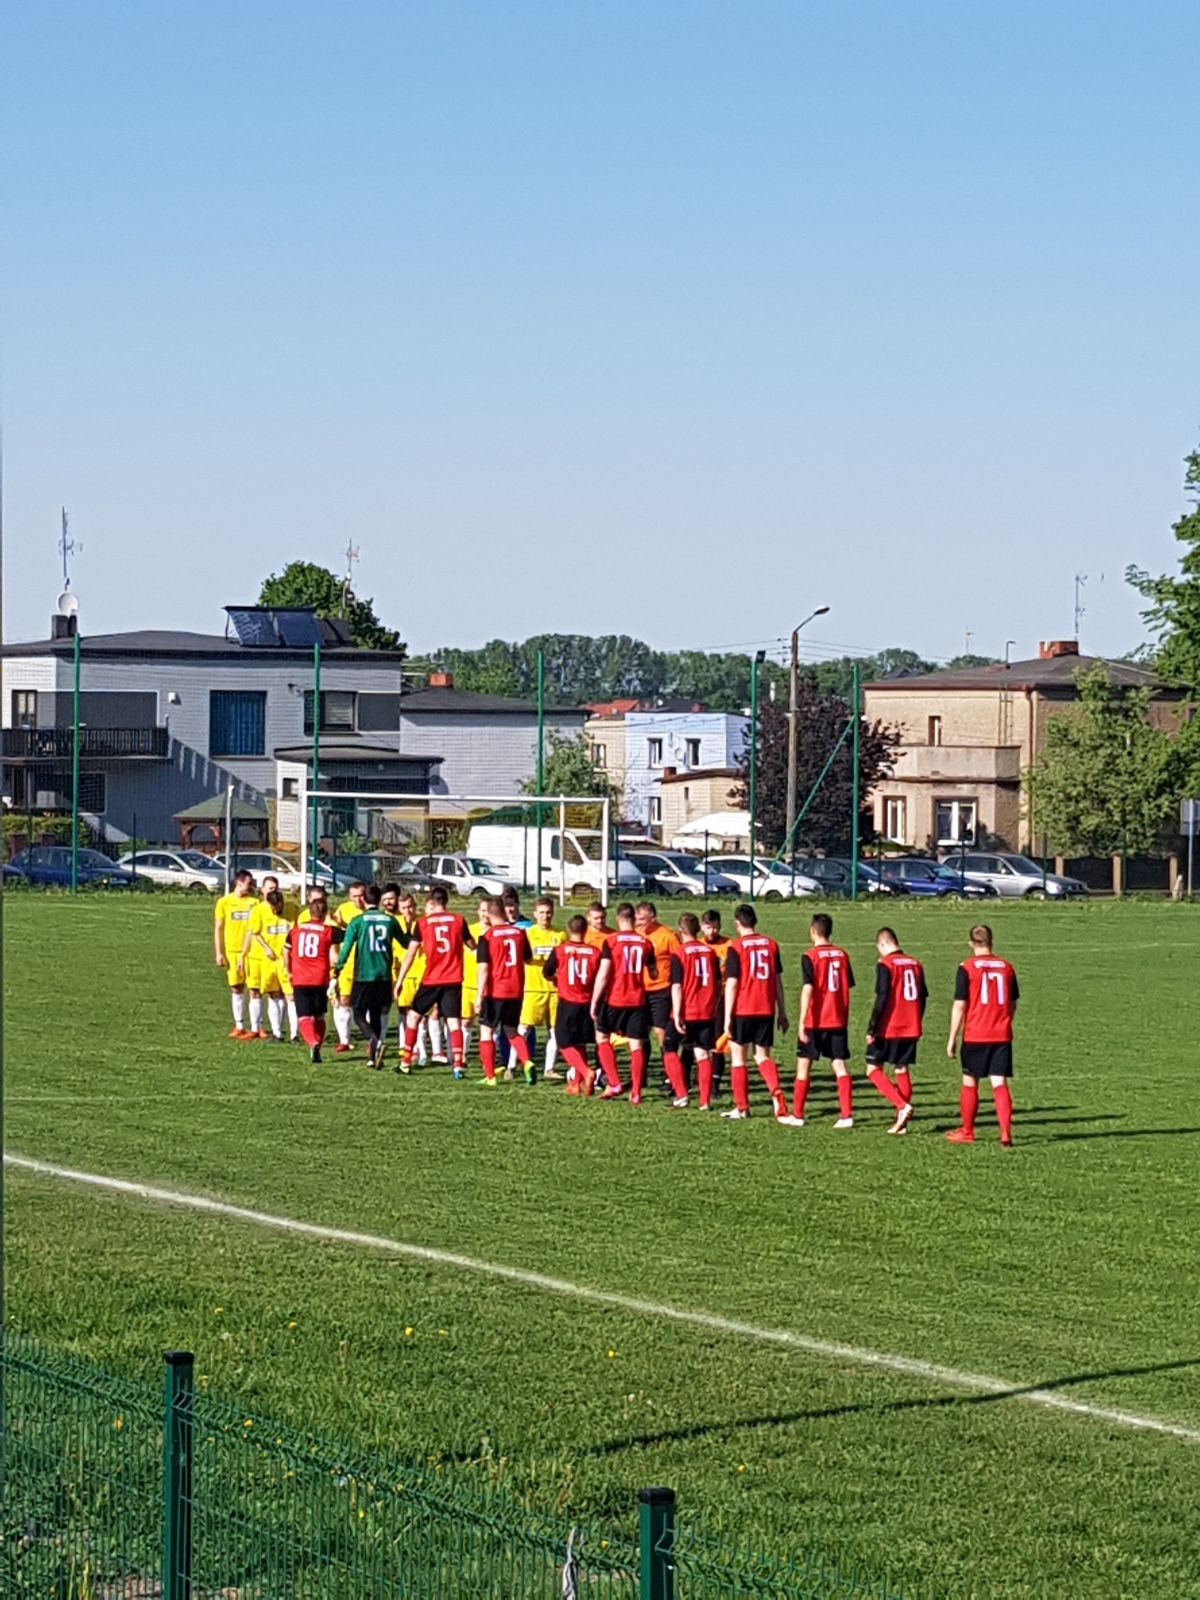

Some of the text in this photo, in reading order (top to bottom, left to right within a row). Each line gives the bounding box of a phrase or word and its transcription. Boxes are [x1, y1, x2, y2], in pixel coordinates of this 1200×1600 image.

[298, 932, 320, 958] 18
[369, 924, 388, 952] 12
[434, 926, 450, 954] 5
[503, 939, 517, 967] 3
[623, 946, 643, 974] 10
[750, 949, 769, 980] 15
[568, 957, 588, 985] 14
[695, 957, 710, 986] 4
[828, 960, 841, 992] 6
[903, 969, 917, 1001] 8
[980, 972, 1005, 1005] 17
